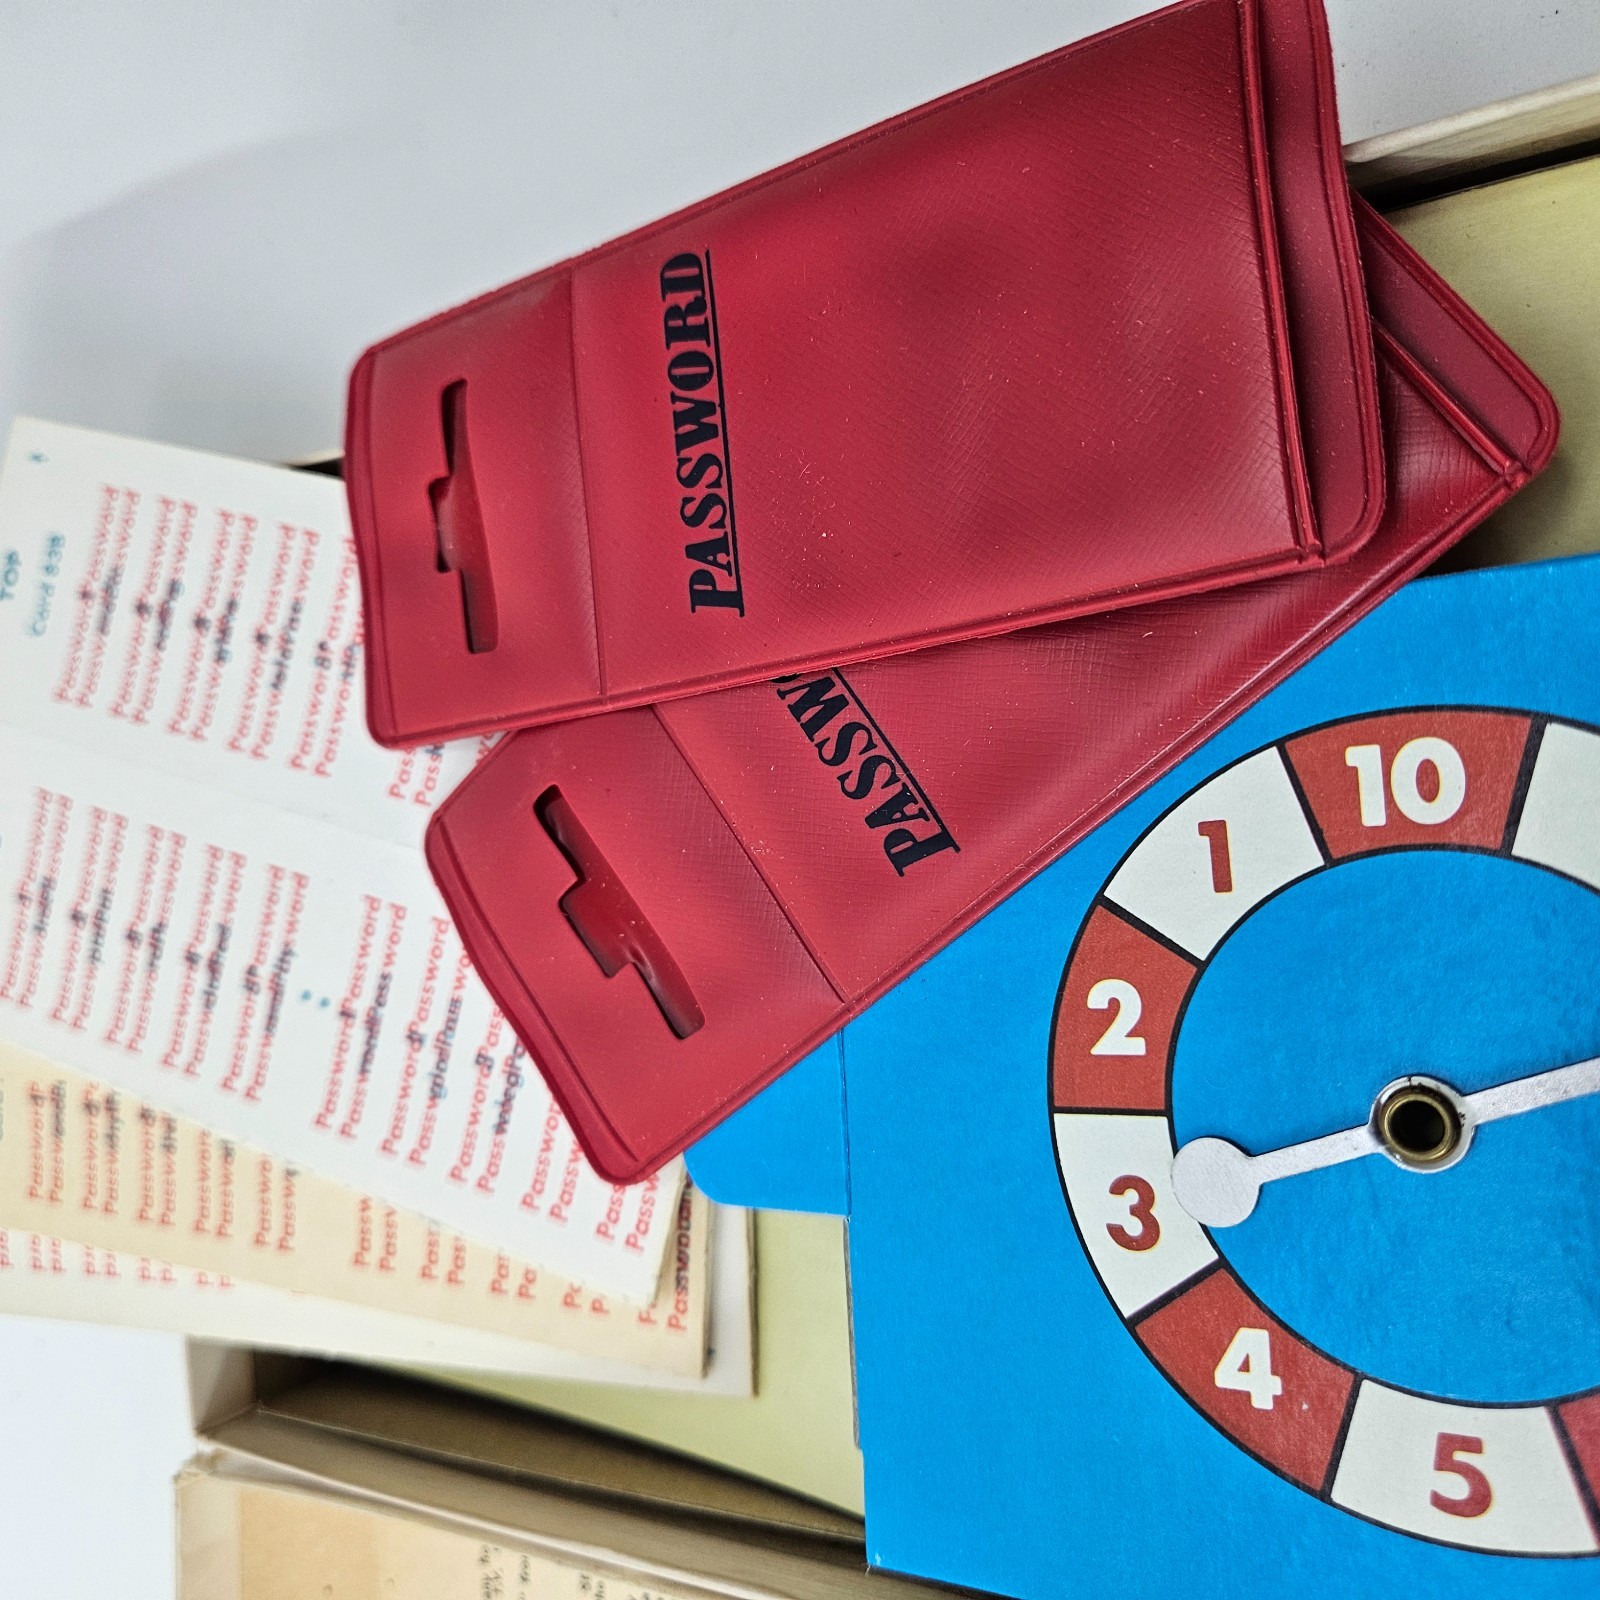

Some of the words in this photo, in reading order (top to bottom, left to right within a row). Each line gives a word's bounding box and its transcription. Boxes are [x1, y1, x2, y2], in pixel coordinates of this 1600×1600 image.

[659, 250, 744, 617] PASSWORD
[770, 668, 958, 877] PASSW
[1345, 735, 1466, 827] 10
[1198, 819, 1233, 893] 1
[1087, 979, 1147, 1057] 2
[1106, 1175, 1160, 1251] 3
[1214, 1327, 1283, 1409] 4
[1430, 1433, 1493, 1518] 5
